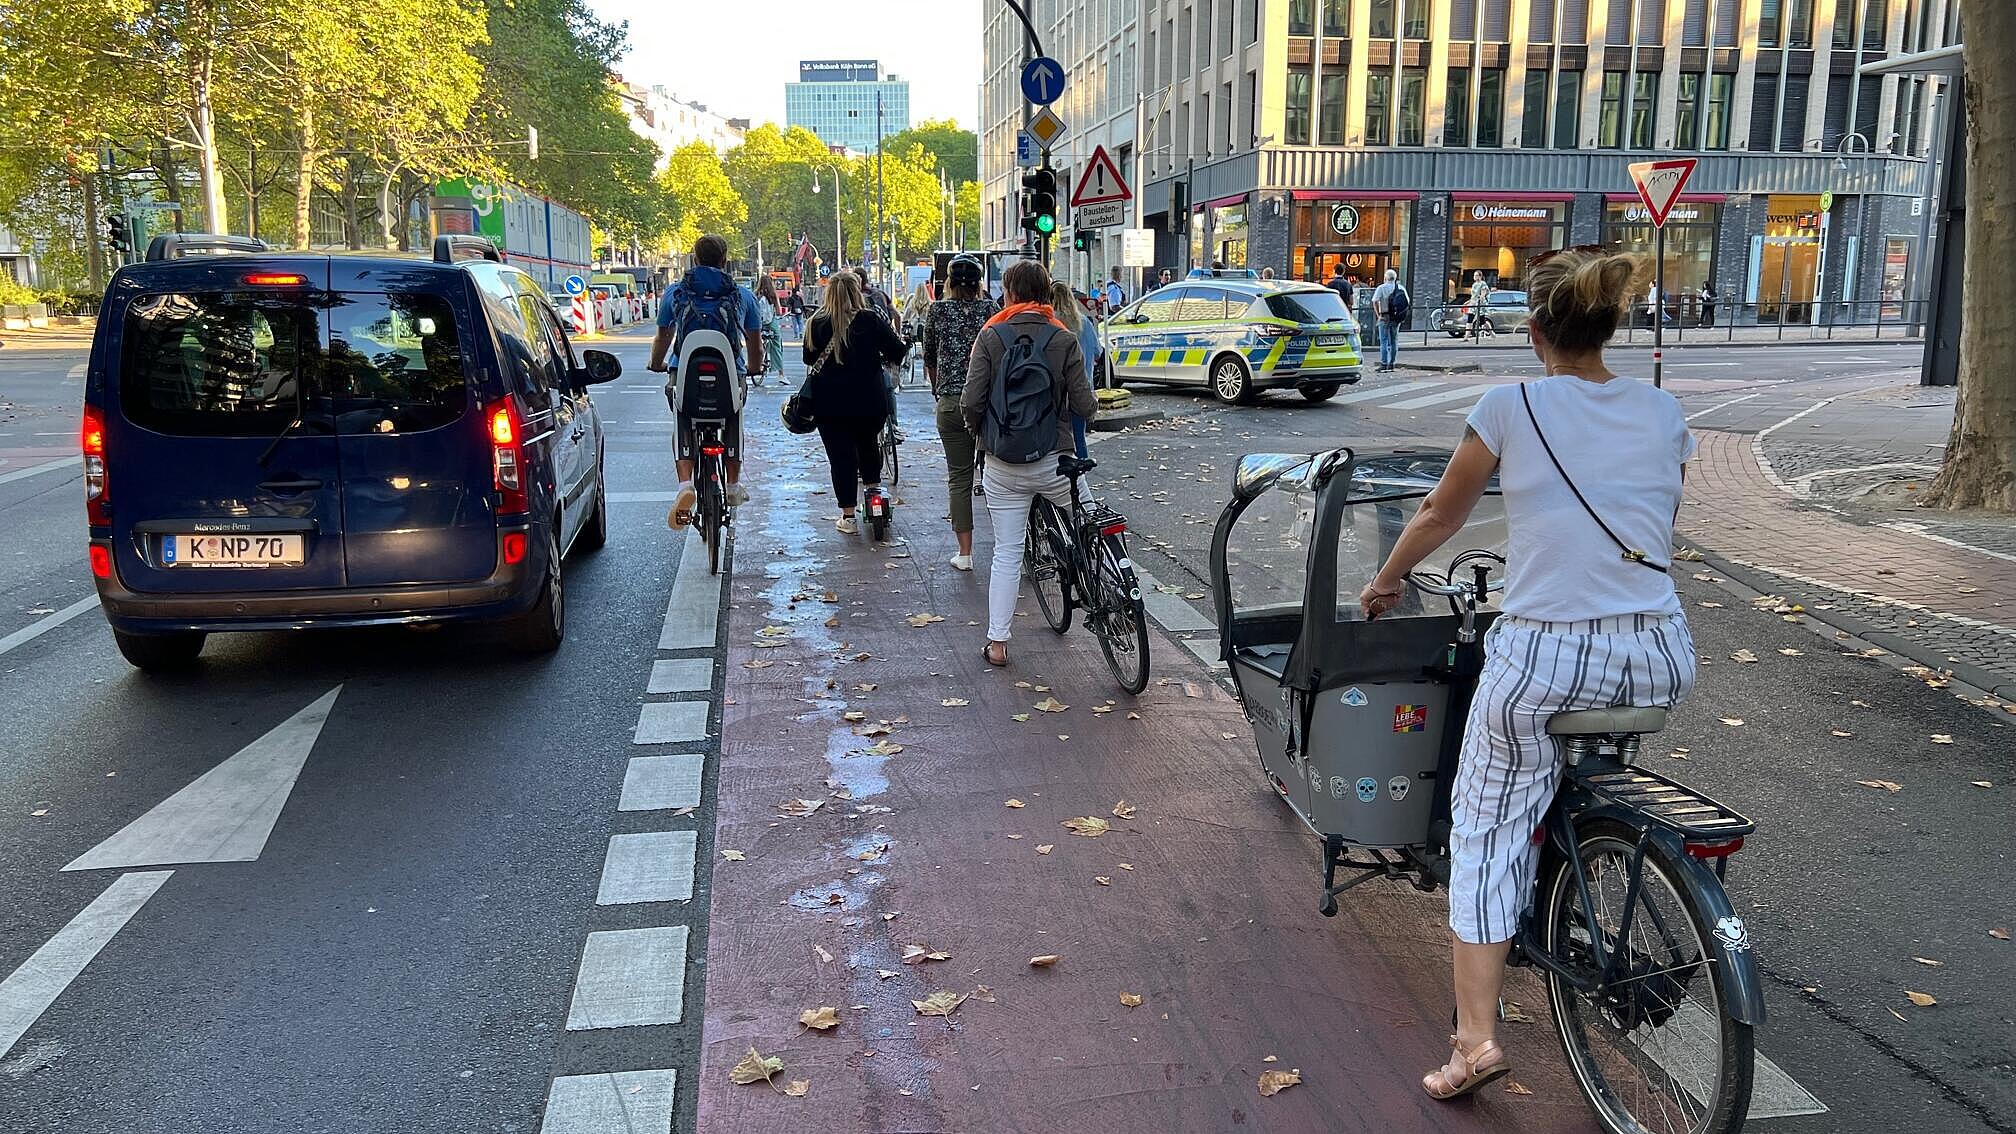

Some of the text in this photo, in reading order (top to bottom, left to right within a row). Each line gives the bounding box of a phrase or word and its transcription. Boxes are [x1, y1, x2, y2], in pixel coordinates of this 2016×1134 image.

[1083, 204, 1119, 216] Baustellen-
[1488, 206, 1547, 218] Heinemann
[1641, 208, 1698, 218] Hmann
[1089, 215, 1115, 226] ausfahrt
[194, 523, 250, 531] Mercedes-Benz
[190, 538, 283, 558] K NP 70
